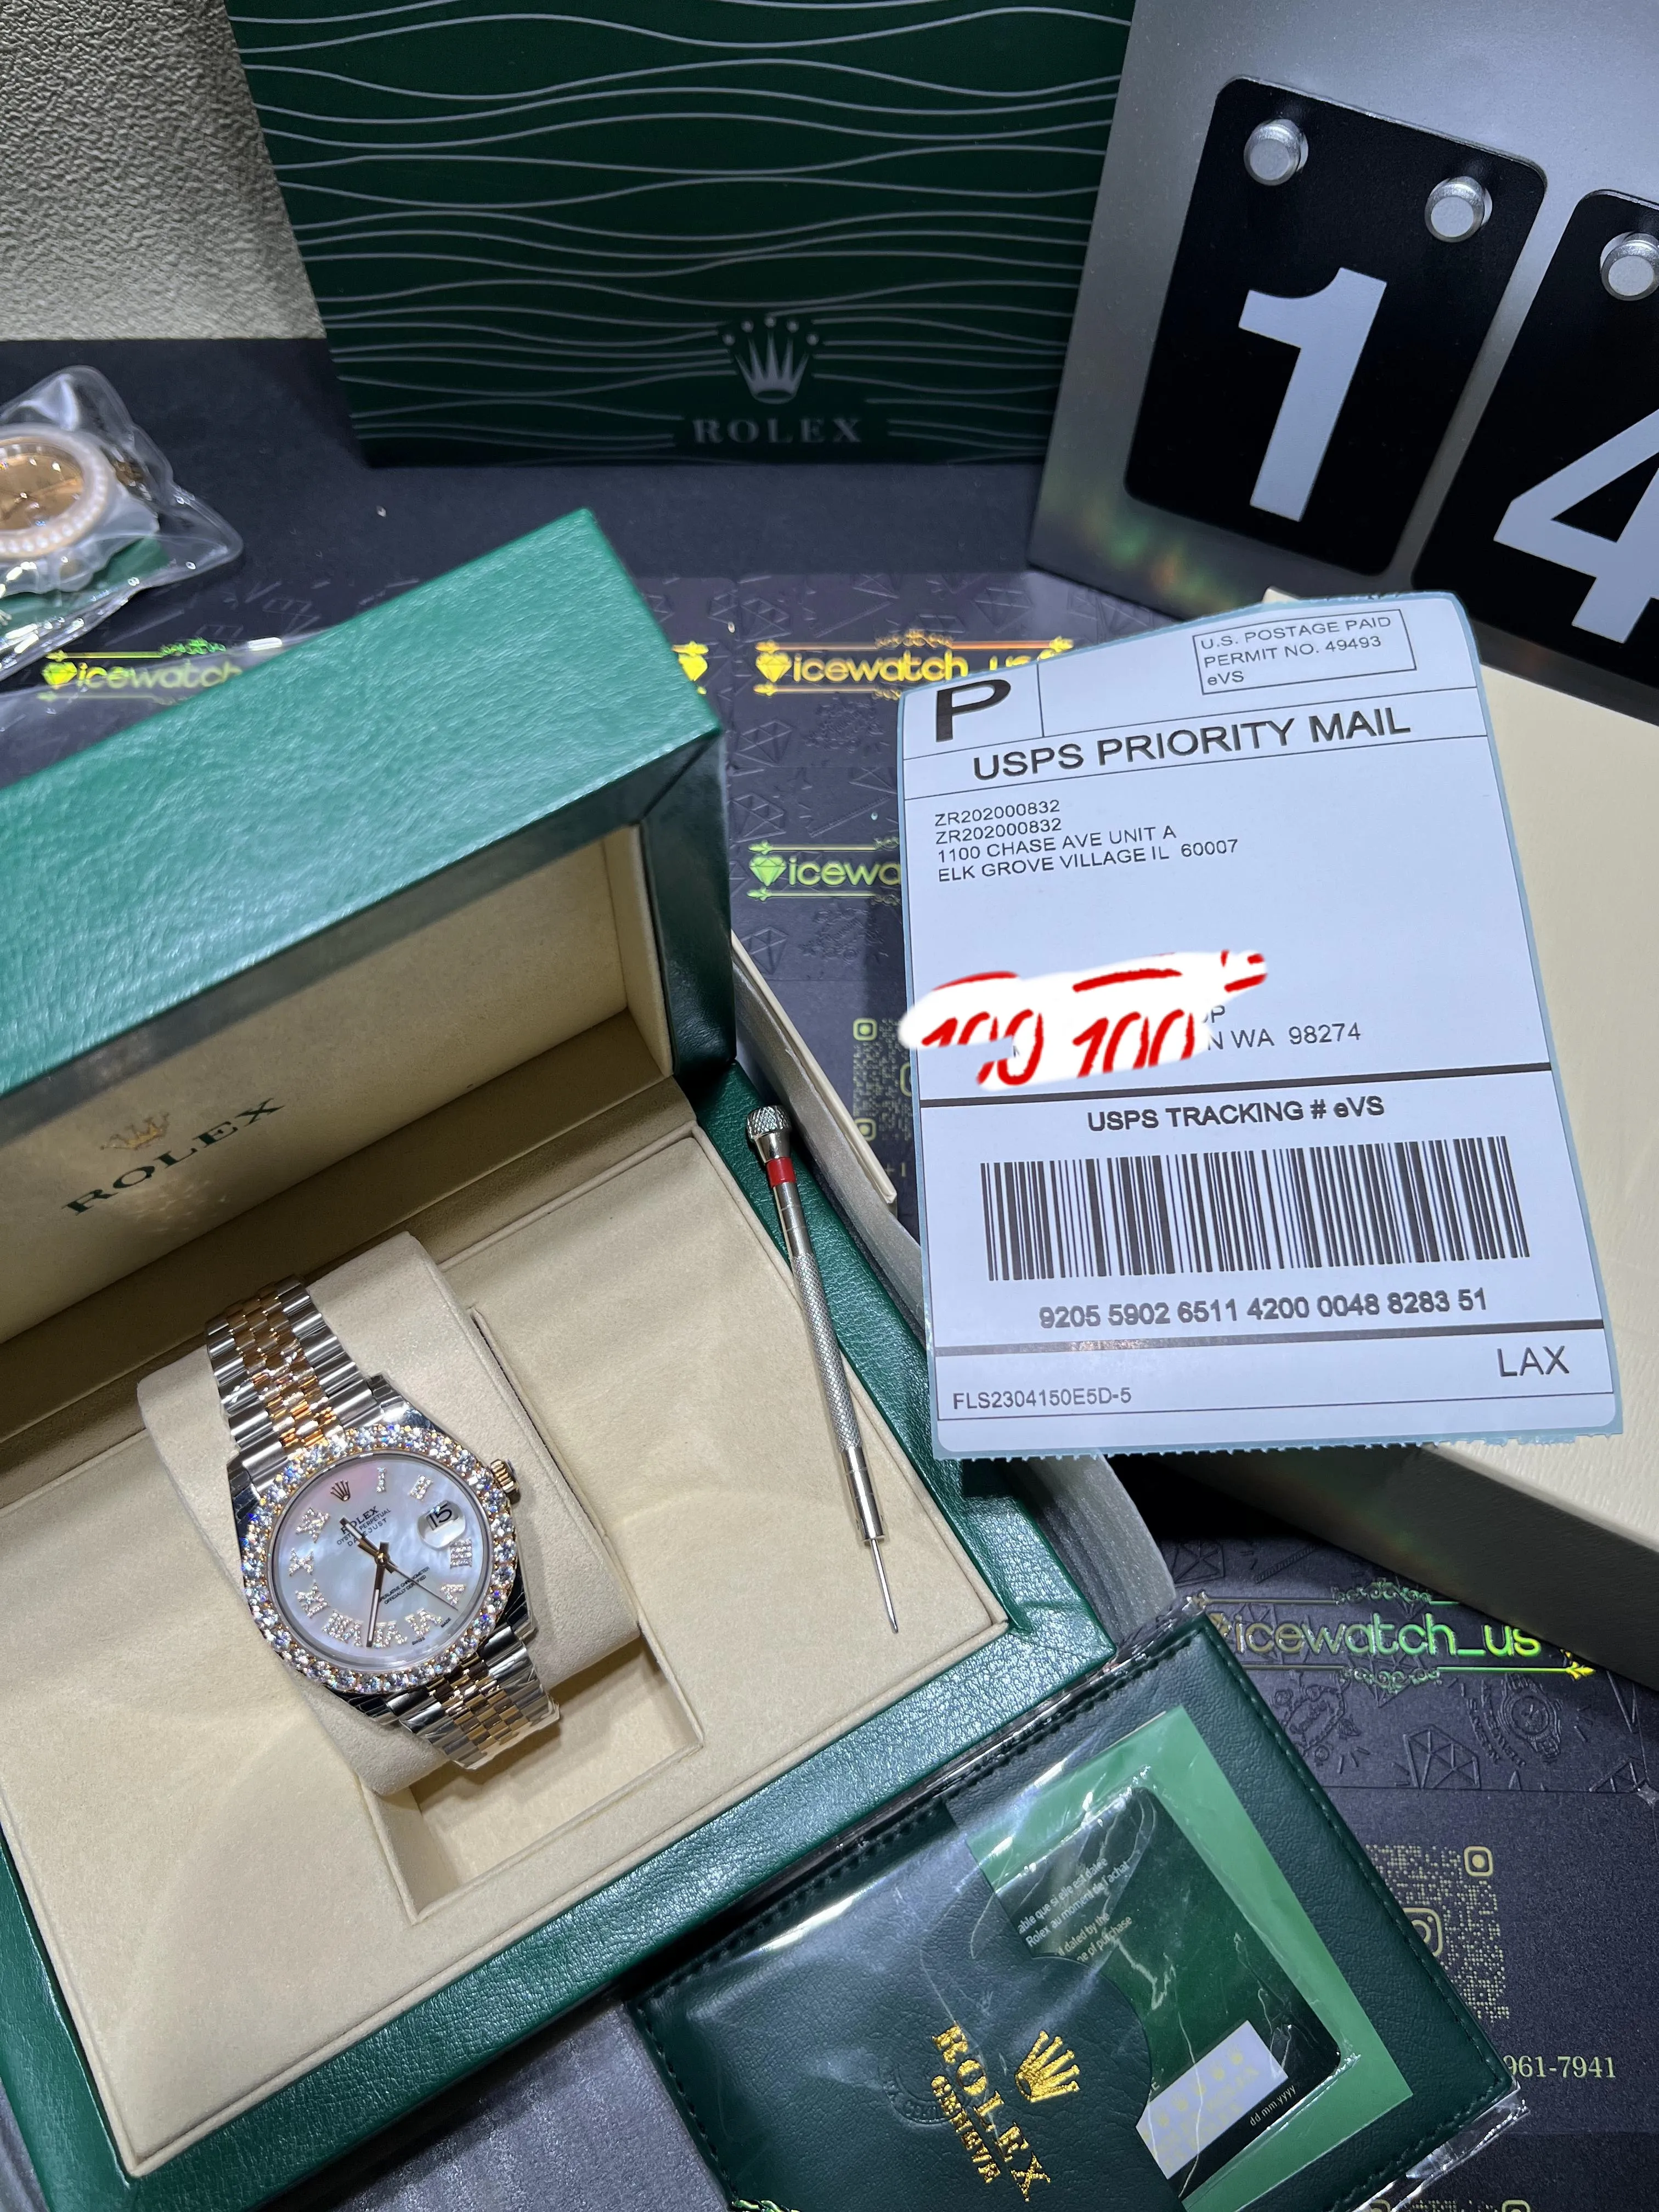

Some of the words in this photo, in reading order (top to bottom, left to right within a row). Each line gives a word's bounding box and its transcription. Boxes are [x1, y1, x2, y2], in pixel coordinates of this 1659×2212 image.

[692, 417, 862, 443] ROLEX
[1200, 636, 1238, 650] U.S.
[1245, 621, 1340, 644] POSTAGE
[1346, 616, 1391, 631] PAID
[1204, 647, 1278, 668] PERMIT
[1284, 642, 1319, 657] NO.
[1325, 636, 1381, 652] 49493
[1207, 670, 1245, 686] eVS
[935, 679, 1012, 743] P
[973, 743, 1085, 781] USPS
[1097, 718, 1295, 766] PRIORITY
[1309, 707, 1411, 743] MAIL
[934, 799, 1060, 827] ZR202000832
[935, 817, 1063, 845] ZR202000832
[938, 845, 981, 864] 1100
[987, 837, 1057, 859] CHASE
[1062, 833, 1102, 850] AVE
[1109, 827, 1155, 845] UNIT
[1163, 825, 1177, 840] A
[938, 865, 975, 882] ELK
[981, 857, 1054, 878] GROVE
[1059, 848, 1146, 870] VILLAGE
[1152, 847, 1170, 861] IL
[1181, 839, 1238, 858] 60007
[1230, 1029, 1274, 1049] WA
[1288, 1022, 1361, 1045] 98274
[1087, 1110, 1159, 1132] USPS
[1165, 1099, 1304, 1127] TRACKING
[1310, 1098, 1327, 1120] #
[1333, 1096, 1385, 1118] eVS
[61, 1098, 285, 1216] ROLEX
[1039, 1305, 1101, 1328] 9205
[1107, 1301, 1170, 1326] 5902
[1177, 1298, 1239, 1324] 6511
[1246, 1295, 1310, 1320] 4200
[1316, 1293, 1380, 1317] 0048
[1387, 1289, 1450, 1313] 8283
[1457, 1287, 1486, 1311] 51
[1496, 1345, 1570, 1378] LAX
[952, 1386, 1132, 1410] FLS2304150E5D-5
[347, 1517, 387, 1547] DAEJUST
[358, 1508, 392, 1531] PERPETUAL
[1025, 1925, 1052, 1947] Rolex
[1050, 1916, 1063, 1929] au
[1060, 1888, 1095, 1920] moment
[1092, 1882, 1105, 1894] de
[1035, 1903, 1052, 1920] que
[1050, 1894, 1059, 1907] si
[1058, 1885, 1074, 1901] elle
[1072, 1874, 1087, 1889] est
[1065, 1928, 1088, 1953] dated
[1085, 1922, 1099, 1936] by
[1094, 1912, 1110, 1927] the
[1087, 1941, 1098, 1956] of
[1096, 1916, 1133, 1951] purchase
[932, 2023, 1051, 2203] ROLEX
